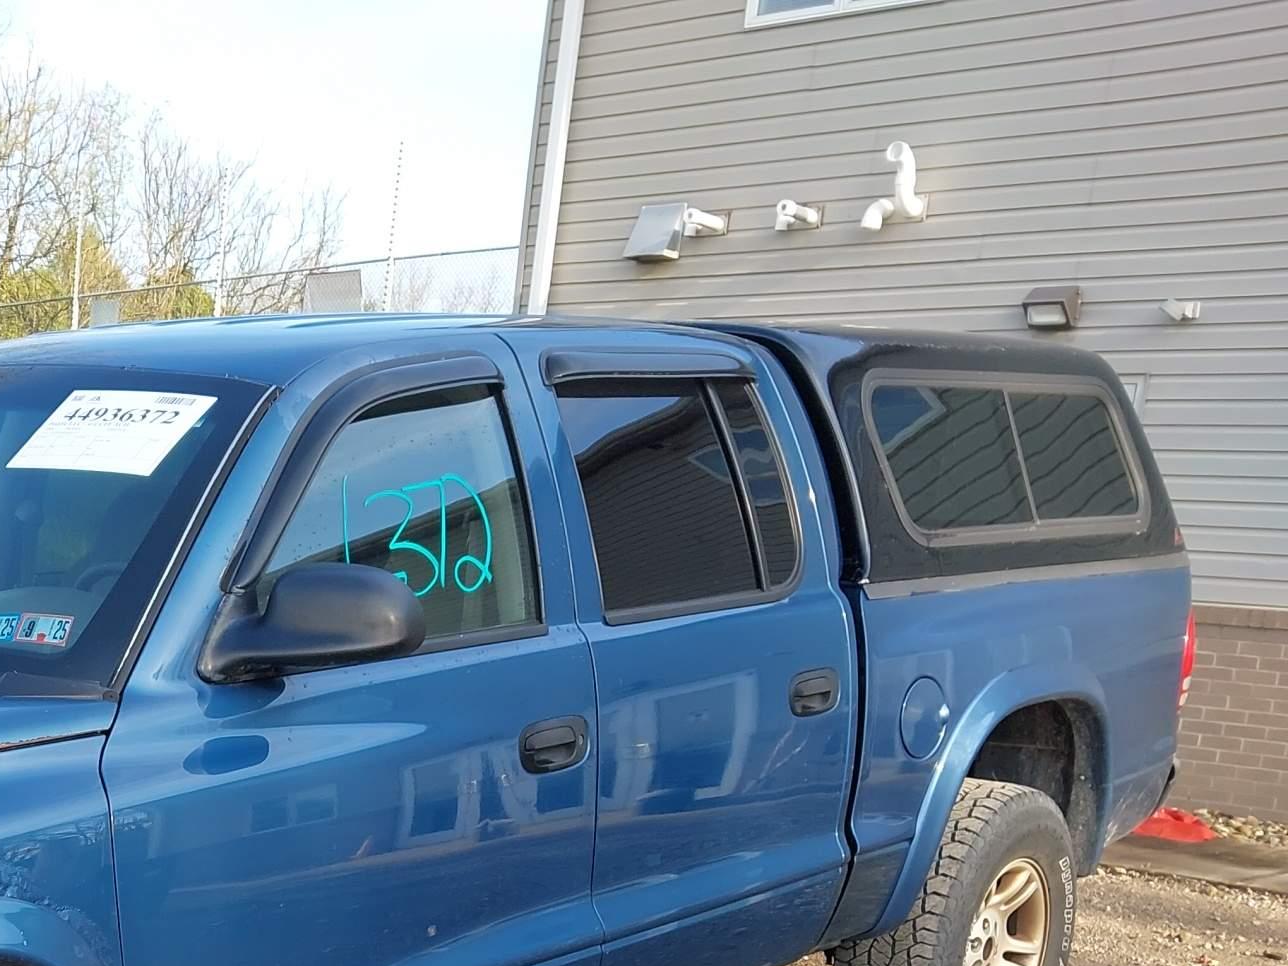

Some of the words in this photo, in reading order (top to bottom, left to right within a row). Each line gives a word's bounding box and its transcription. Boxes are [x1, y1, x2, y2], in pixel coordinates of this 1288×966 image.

[64, 407, 180, 425] 44936372
[0, 618, 17, 637] 25
[53, 620, 70, 640] 25
